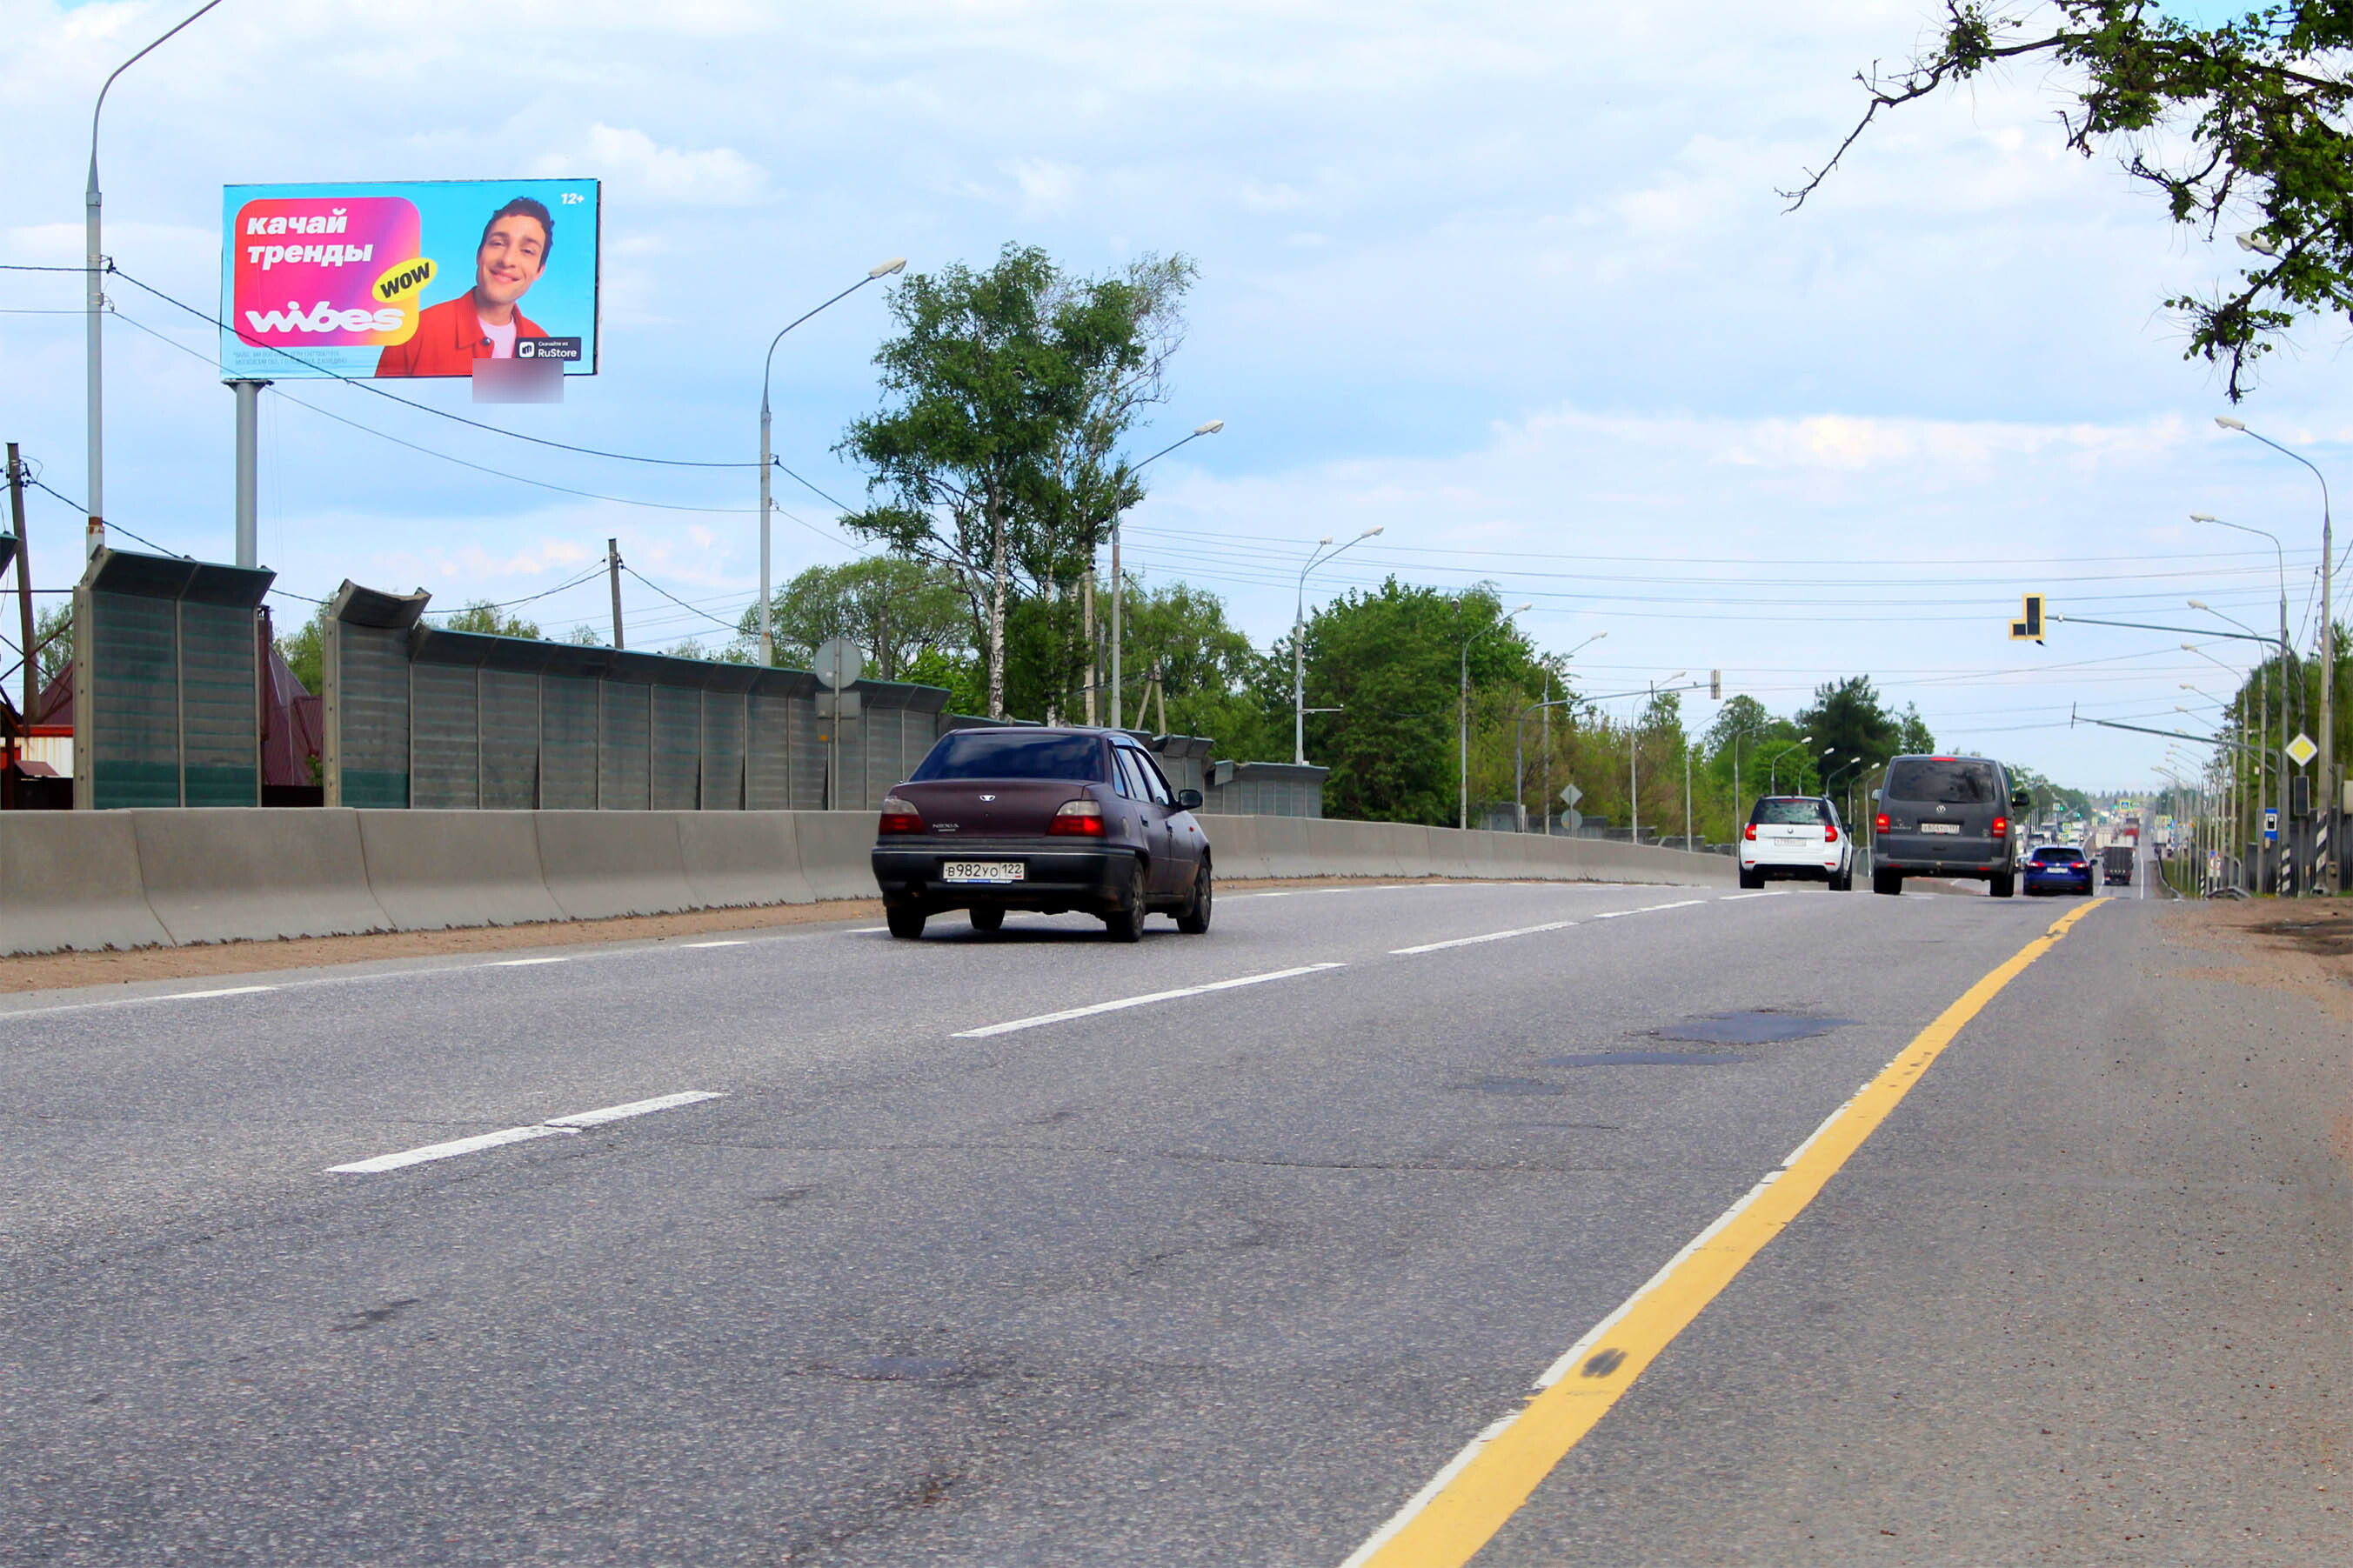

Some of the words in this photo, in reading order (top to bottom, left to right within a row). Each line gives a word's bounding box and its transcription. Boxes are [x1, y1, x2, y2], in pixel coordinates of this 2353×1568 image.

[560, 192, 585, 204] 12+
[246, 208, 348, 235] качай
[247, 244, 374, 270] тренды
[244, 301, 405, 333] wibes
[538, 348, 578, 357] RuStore
[1001, 864, 1023, 874] 122
